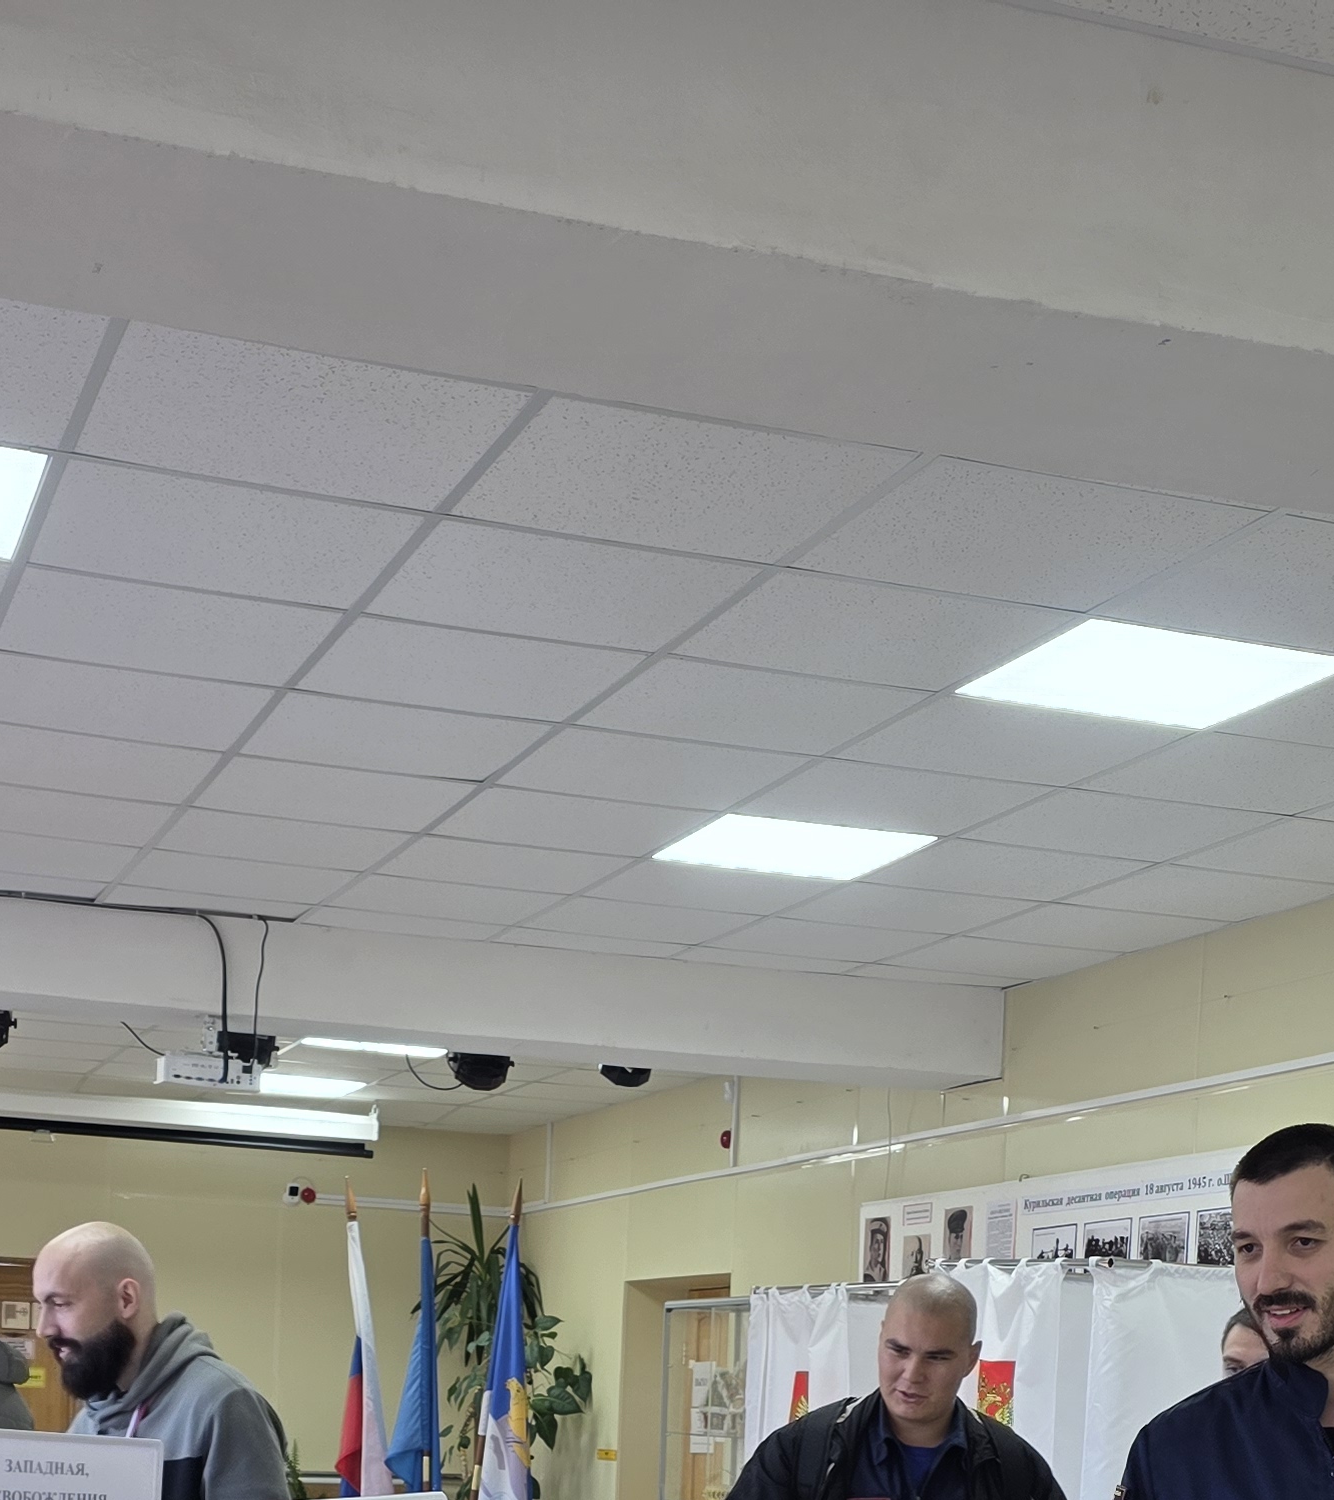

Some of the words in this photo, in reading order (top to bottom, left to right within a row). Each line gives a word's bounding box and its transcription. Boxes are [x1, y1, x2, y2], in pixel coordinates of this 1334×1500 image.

[1023, 1197, 1064, 1213] Курильская
[1104, 1187, 1141, 1204] операция
[1187, 1176, 1207, 1190] 1945
[4, 1459, 89, 1478] ЗАПАДНАЯ,
